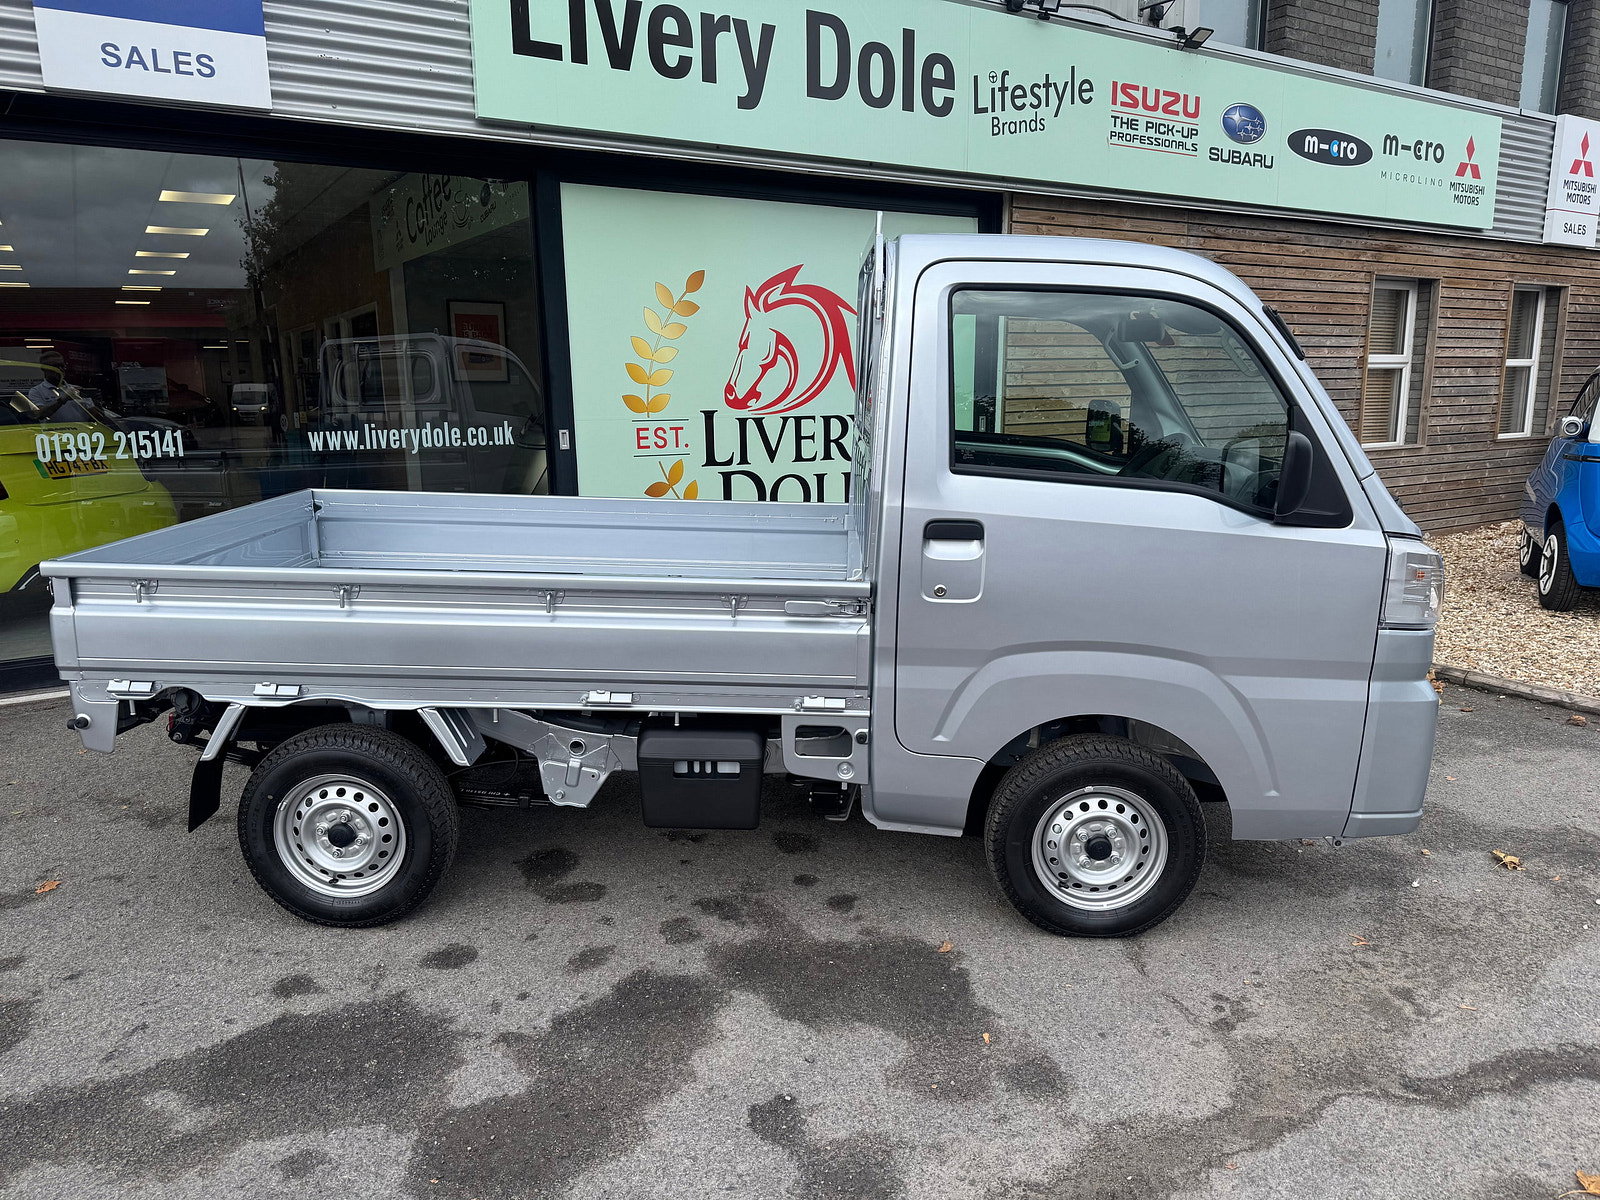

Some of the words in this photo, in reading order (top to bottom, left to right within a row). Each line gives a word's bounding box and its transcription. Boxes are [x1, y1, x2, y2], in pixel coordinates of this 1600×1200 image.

[101, 42, 216, 78] SALES
[510, 0, 777, 110] Livery
[806, 9, 956, 118] Dole
[973, 65, 1094, 118] Lifestyle
[1111, 80, 1201, 119] ISUZU
[991, 111, 1046, 137] Brands
[1110, 115, 1139, 132] THE
[1145, 119, 1199, 140] PICK-UP
[1109, 130, 1199, 153] PROFESSIONALS
[1208, 146, 1274, 169] SUBARU
[1380, 170, 1444, 188] MICROLINO
[1449, 181, 1485, 196] MITSUBISHI
[1562, 178, 1597, 195] MITSUBISHI
[1453, 192, 1480, 206] MOTORS
[1565, 192, 1592, 206] MOTORS
[1563, 221, 1587, 236] SALES
[35, 431, 108, 462] 01392
[113, 429, 185, 460] 215141
[307, 420, 515, 455] www.liverydole.co.uk
[635, 426, 689, 450] EST.
[700, 409, 855, 467] LIVER
[718, 470, 851, 503] DO
